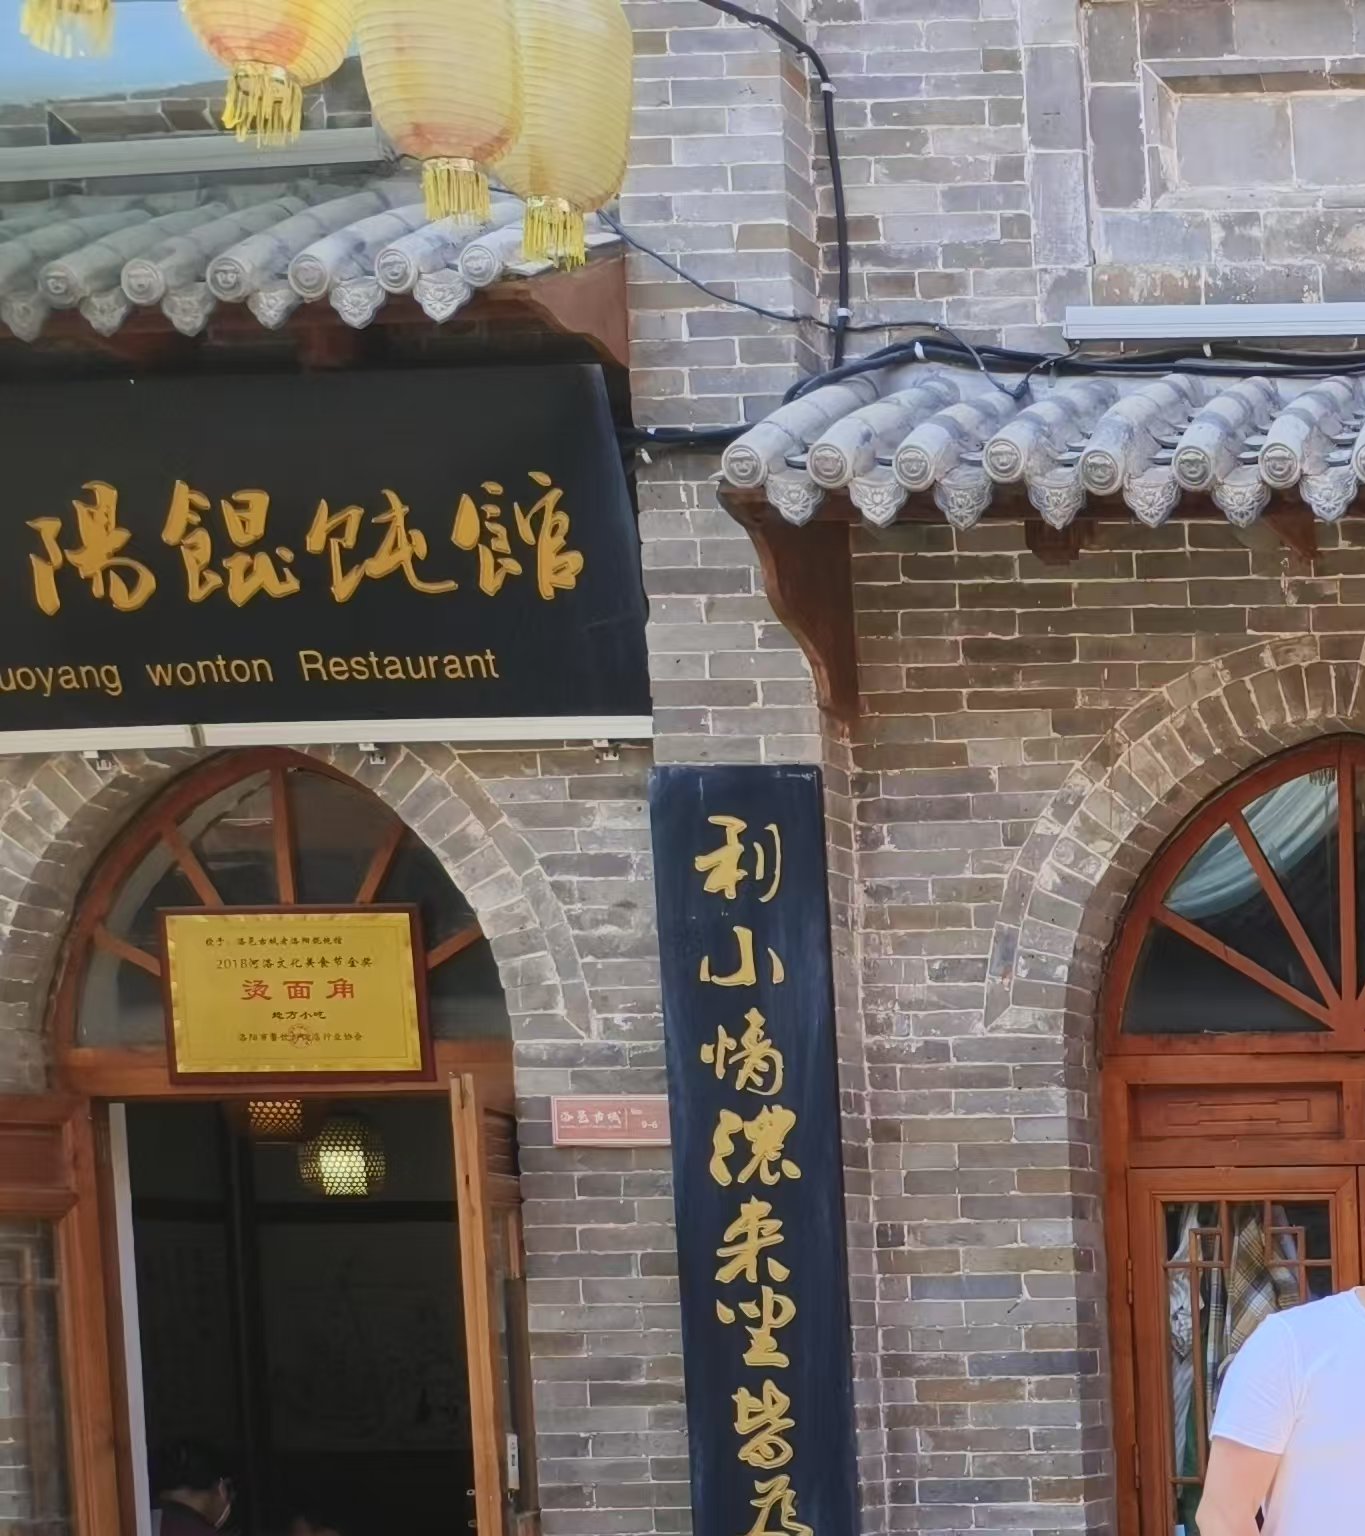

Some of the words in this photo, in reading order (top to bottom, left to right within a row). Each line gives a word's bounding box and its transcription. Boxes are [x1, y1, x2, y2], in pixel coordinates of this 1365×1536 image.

[145, 654, 274, 687] wonton
[300, 649, 500, 681] Restaurant
[241, 977, 355, 1000] 烫面角
[271, 1010, 327, 1020] 地方小吃
[641, 1120, 658, 1129] 9-6
